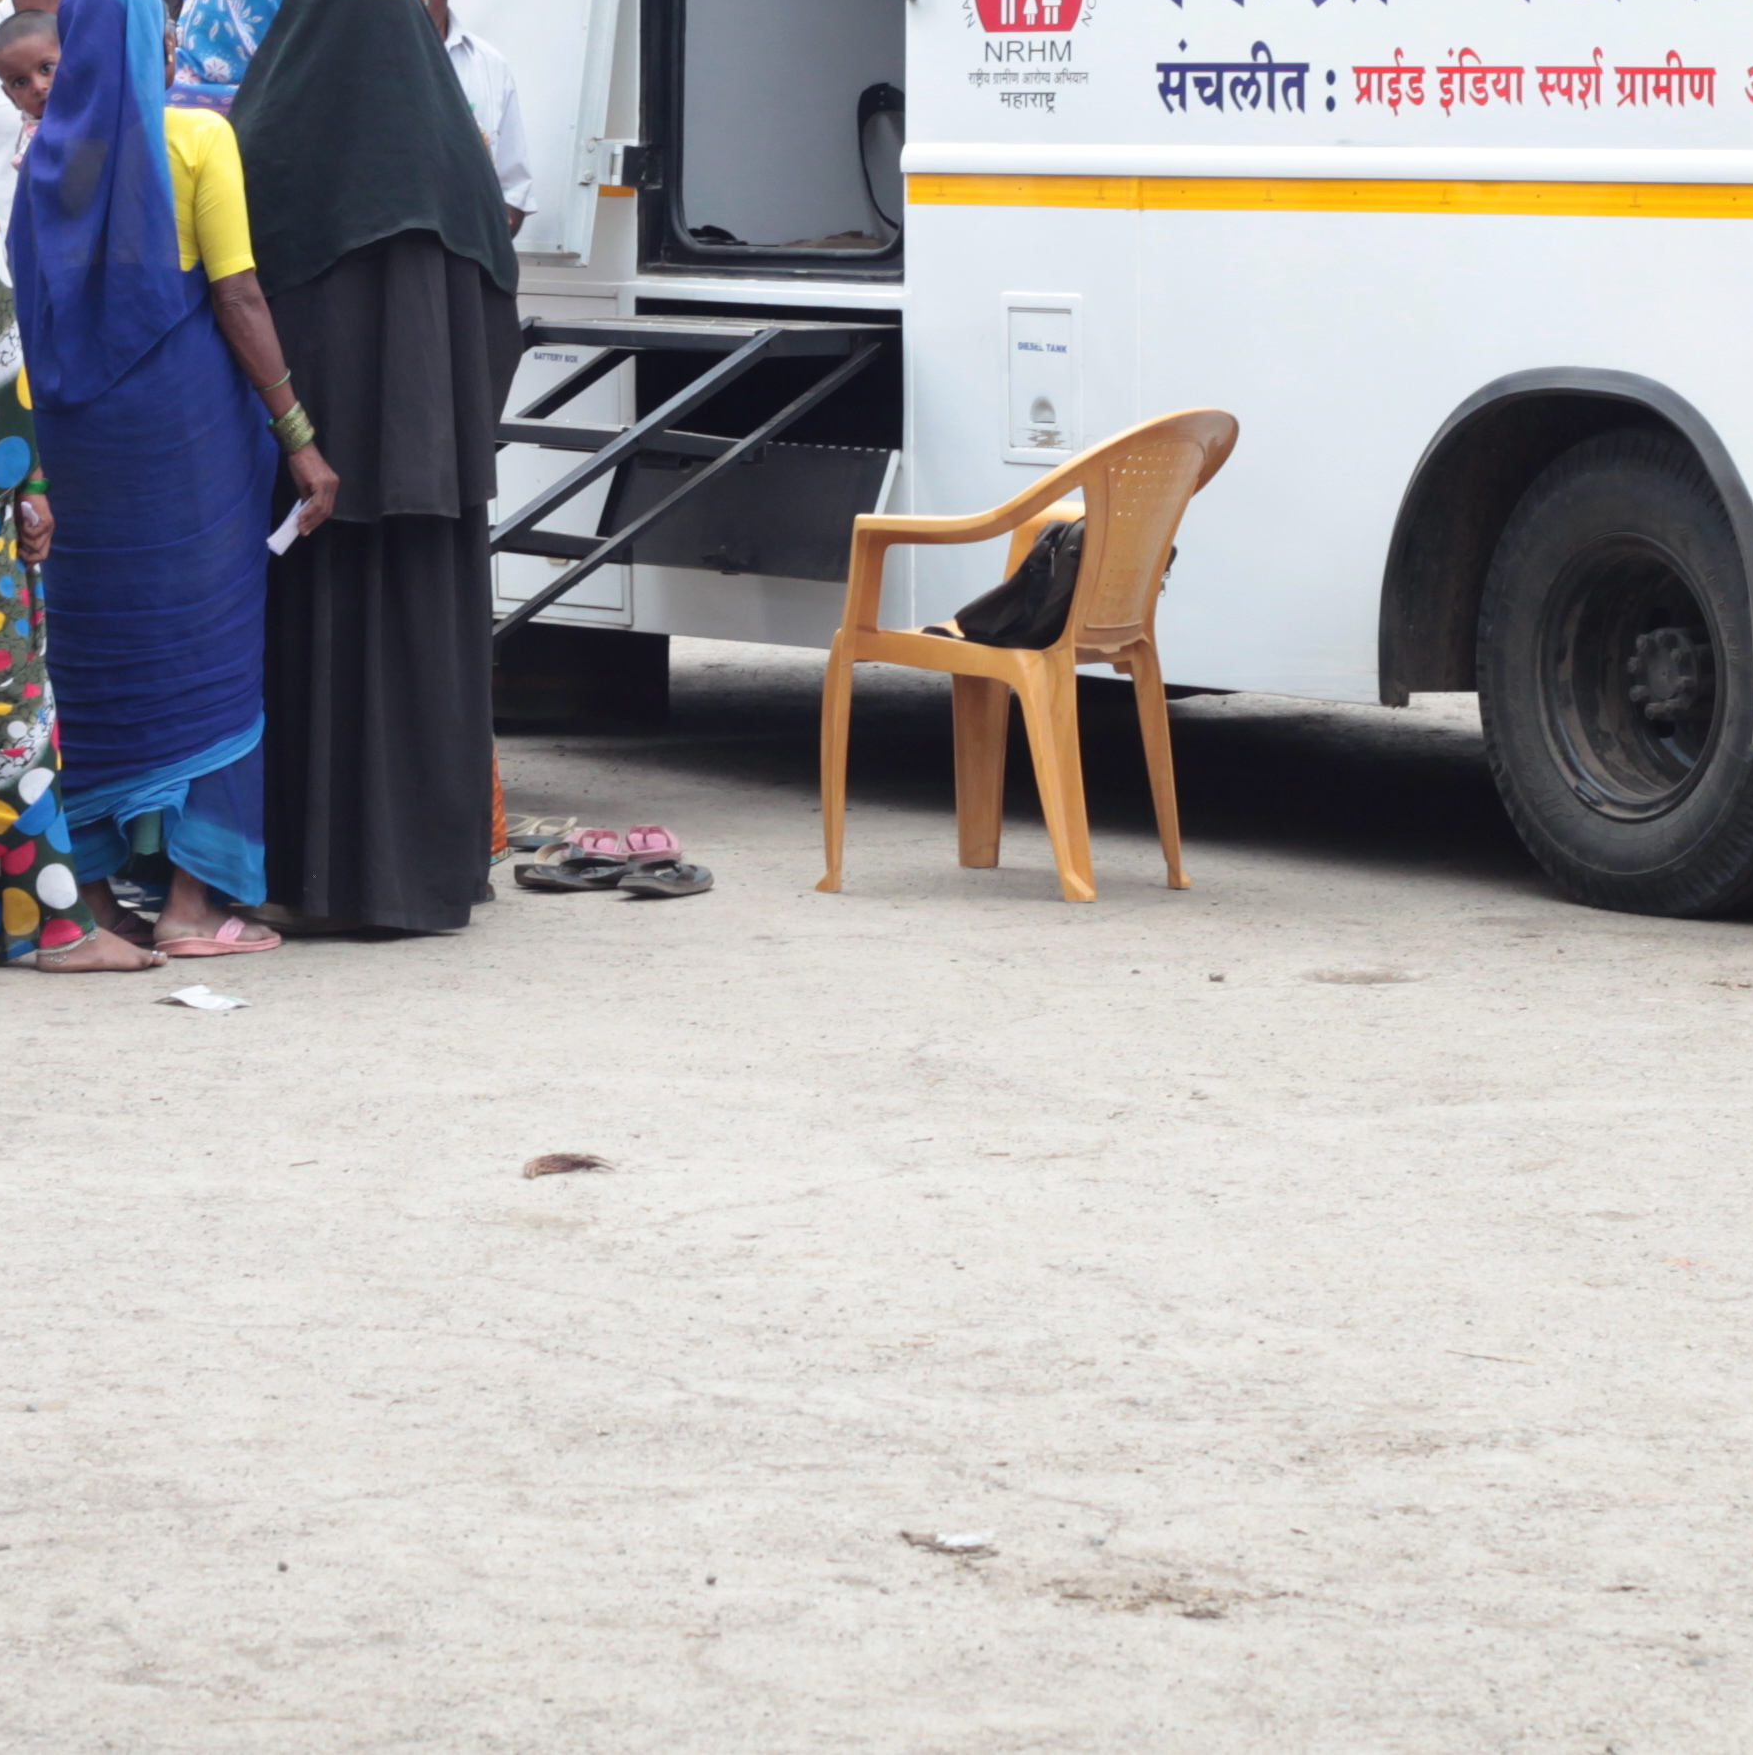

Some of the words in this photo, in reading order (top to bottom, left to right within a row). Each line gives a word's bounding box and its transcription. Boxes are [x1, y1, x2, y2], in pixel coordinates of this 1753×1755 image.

[984, 39, 1072, 63] NRHM
[993, 68, 1019, 84] ग्रामीण
[1022, 69, 1051, 84] आरोग्य
[1054, 68, 1089, 84] अभियान
[1156, 39, 1310, 114] संचलीत
[1352, 47, 1426, 116] प्राईड
[1436, 47, 1525, 116] इंडिया
[1535, 47, 1603, 110] स्पर्श
[1614, 50, 1717, 107] ग्रामीण
[1000, 91, 1057, 113] महाराष्ट्र
[1046, 344, 1067, 353] TANK
